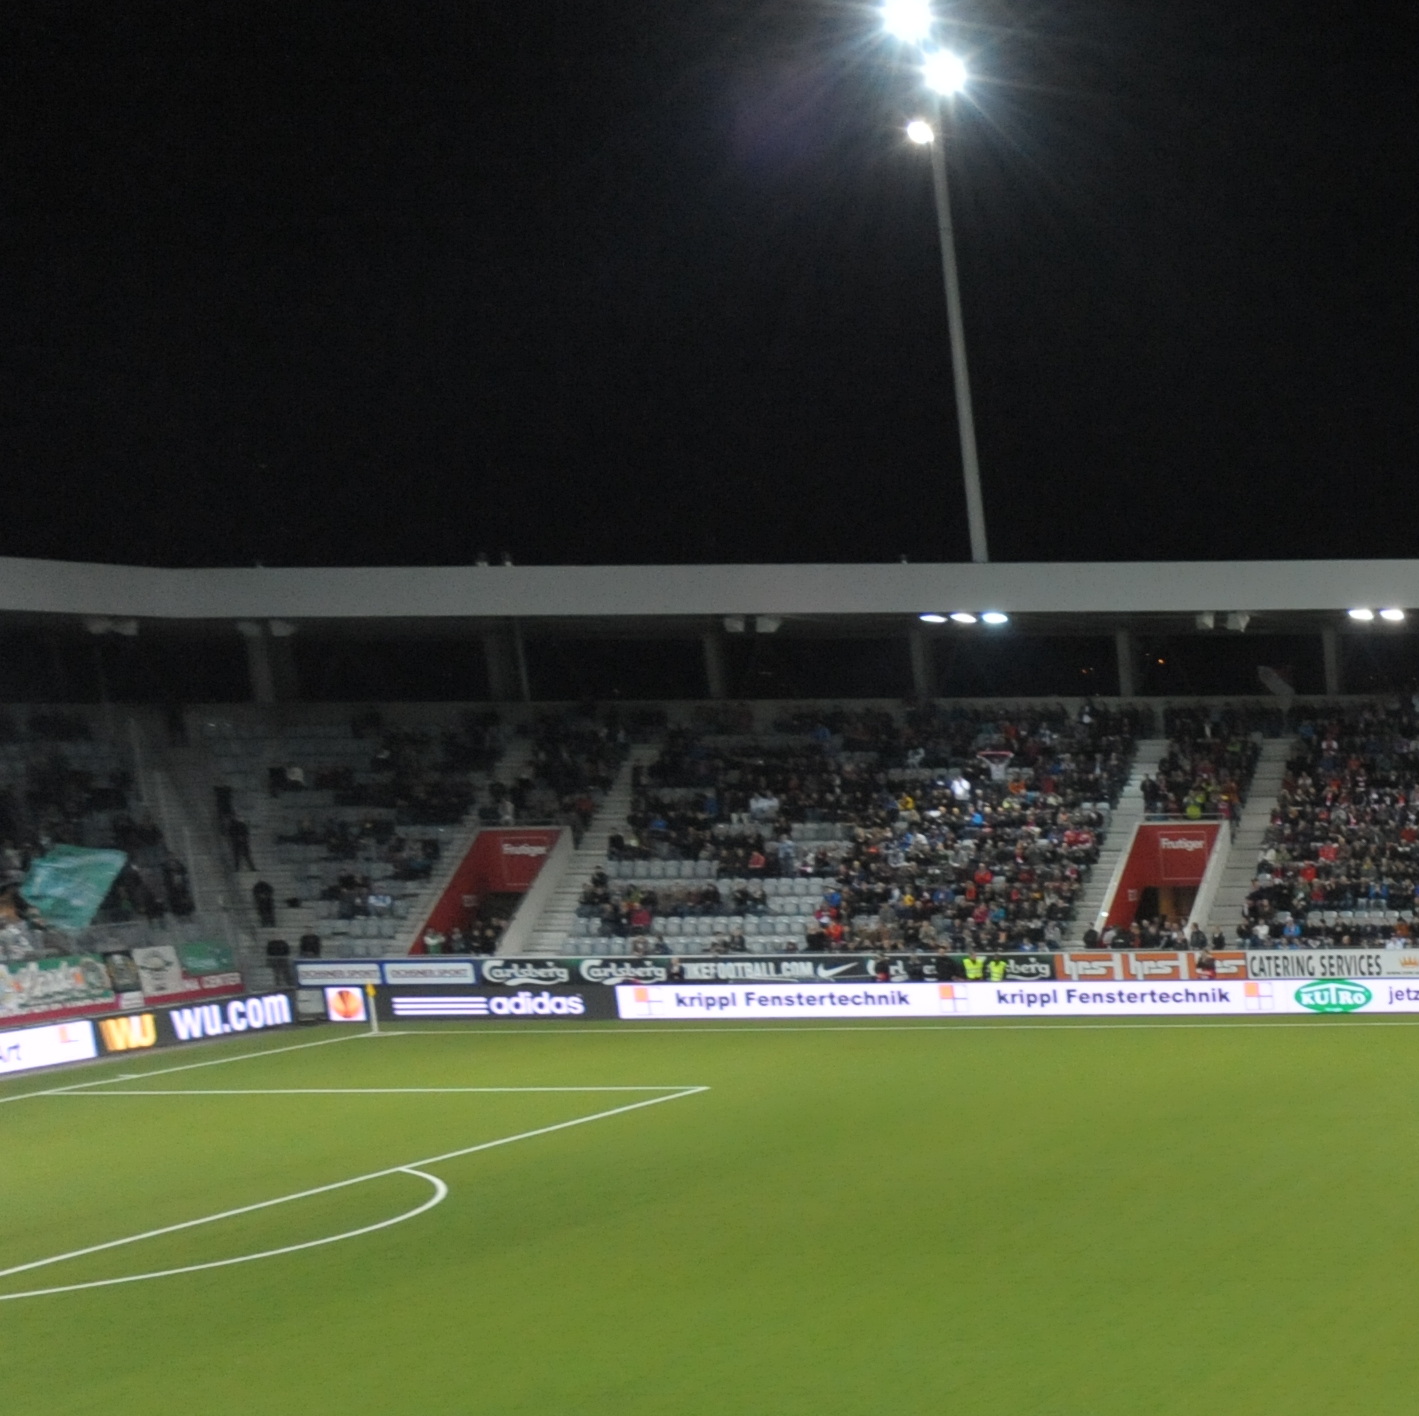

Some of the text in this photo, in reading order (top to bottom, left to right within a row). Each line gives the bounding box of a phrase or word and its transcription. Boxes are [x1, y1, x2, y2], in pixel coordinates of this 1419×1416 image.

[1160, 838, 1204, 851] Frutiger
[482, 959, 569, 984] Carlsberg
[580, 959, 667, 984] Carlsberg
[678, 961, 815, 980] IKEFOOTBALL.COM
[1252, 955, 1315, 977] CATERING
[1320, 954, 1382, 976] SERVICES
[489, 991, 585, 1015] adidas
[675, 990, 910, 1011] krippl Fenstertechnik
[997, 988, 1230, 1008] krippl Fenstertechnik
[1300, 983, 1366, 1005] KUTRO
[102, 1014, 157, 1051] WU
